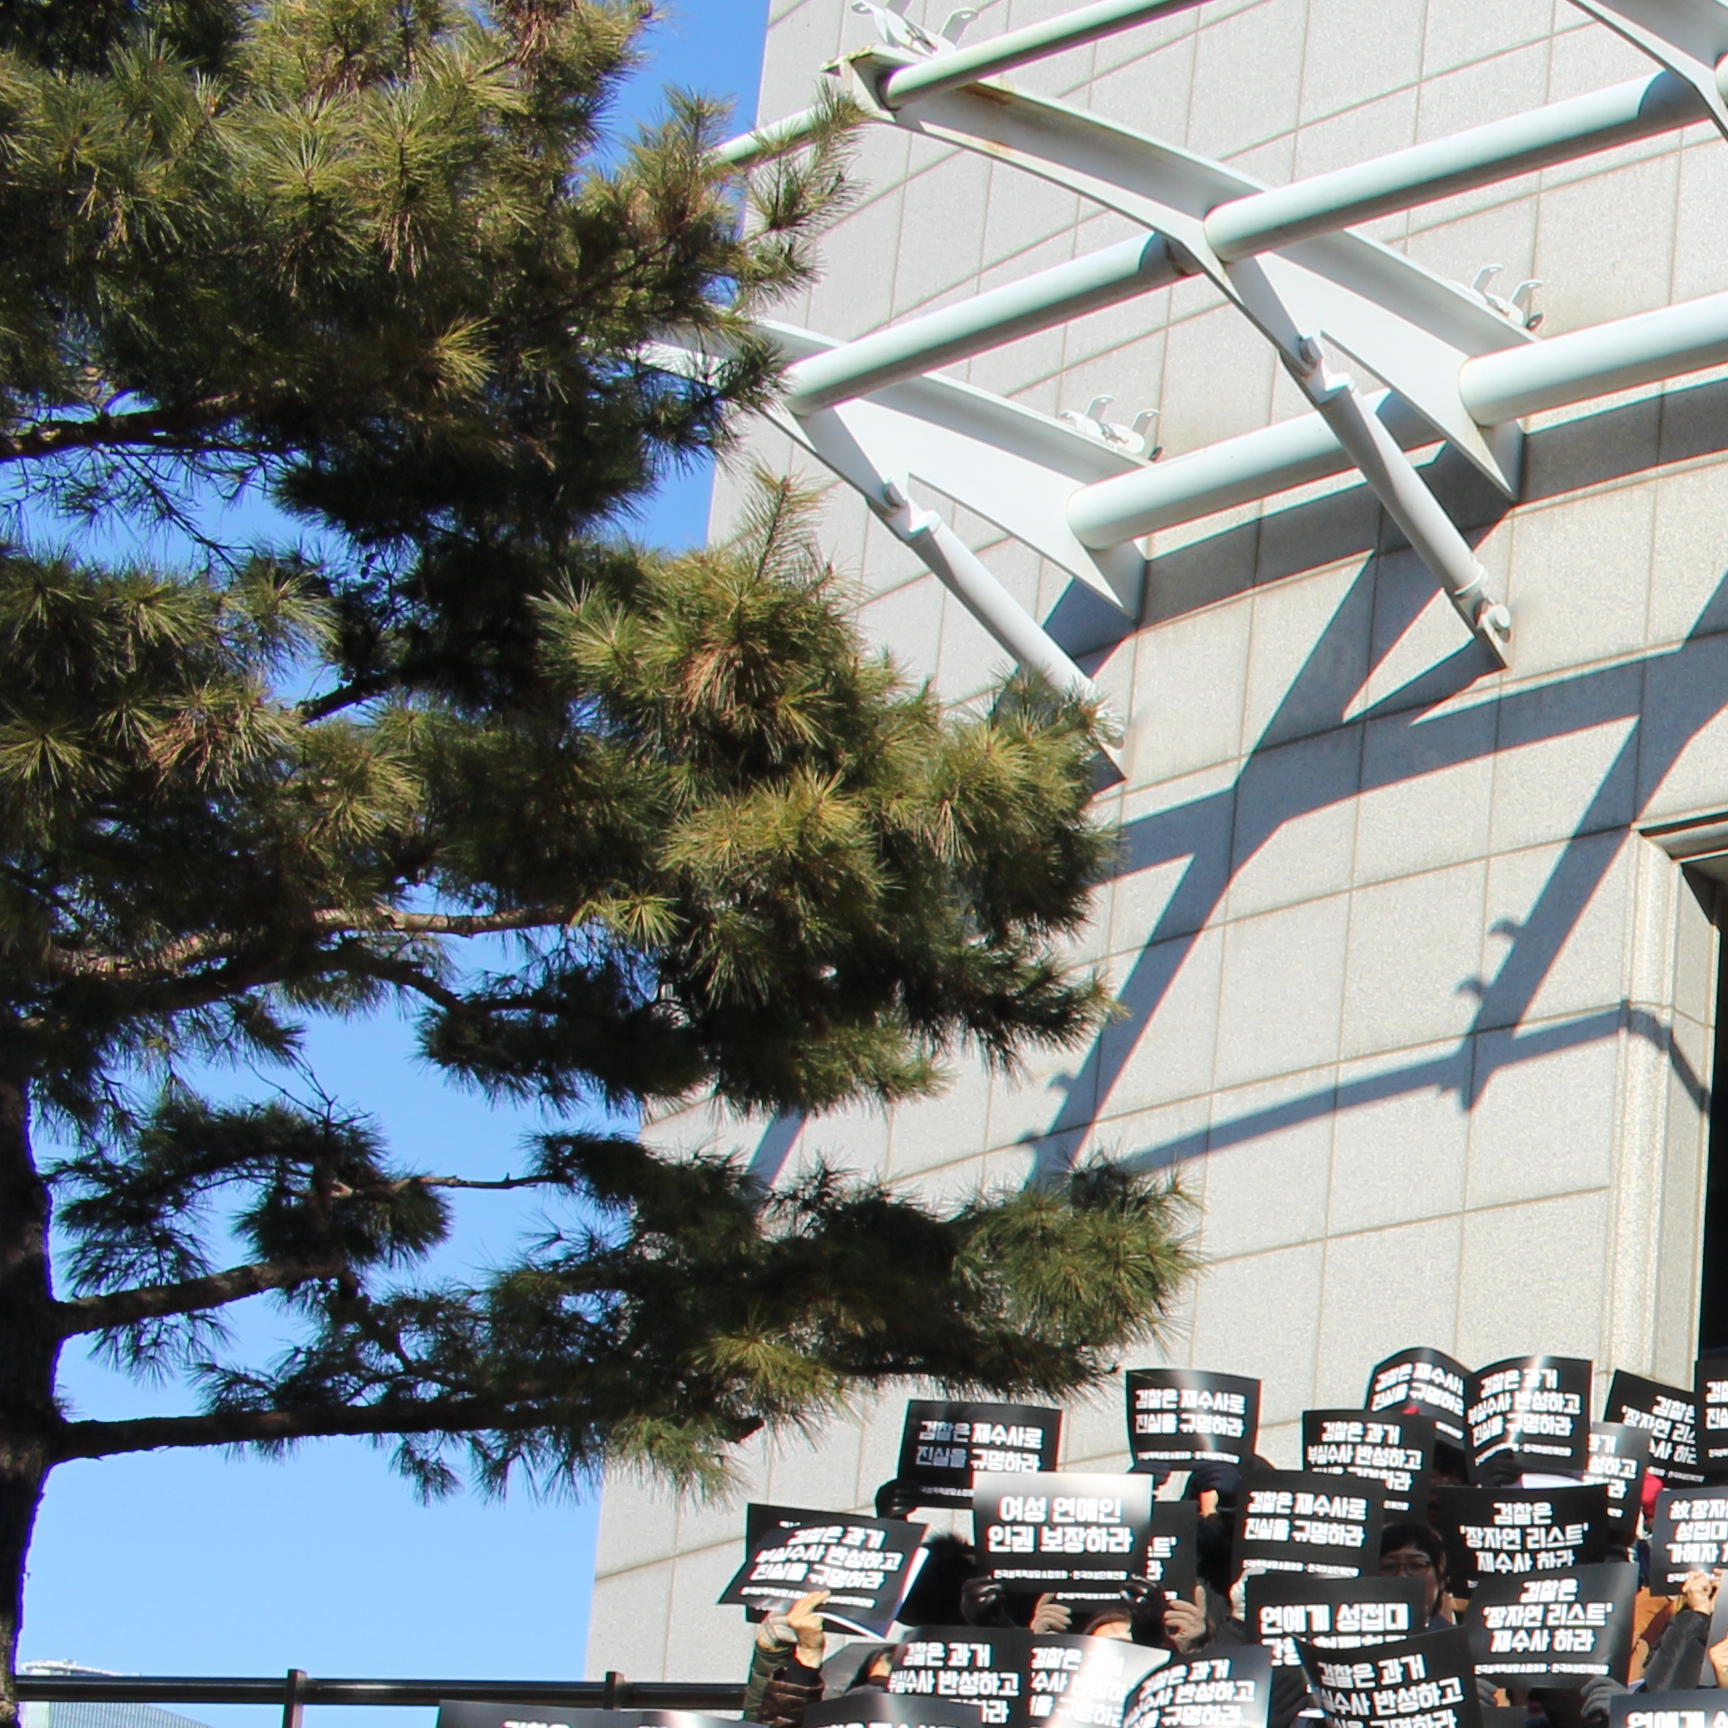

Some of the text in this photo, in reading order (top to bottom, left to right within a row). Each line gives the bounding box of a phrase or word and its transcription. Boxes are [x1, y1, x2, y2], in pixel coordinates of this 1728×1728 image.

[1136, 1389, 1244, 1413] 검찰은 재수사로
[1136, 1413, 1243, 1438] 진실을 규명하라
[1001, 1496, 1121, 1523] 여성 연예인
[989, 1526, 1132, 1552] 인권 보장하라
[1520, 1579, 1577, 1603] 검찰은
[1491, 1629, 1594, 1652] 재수사 하라
